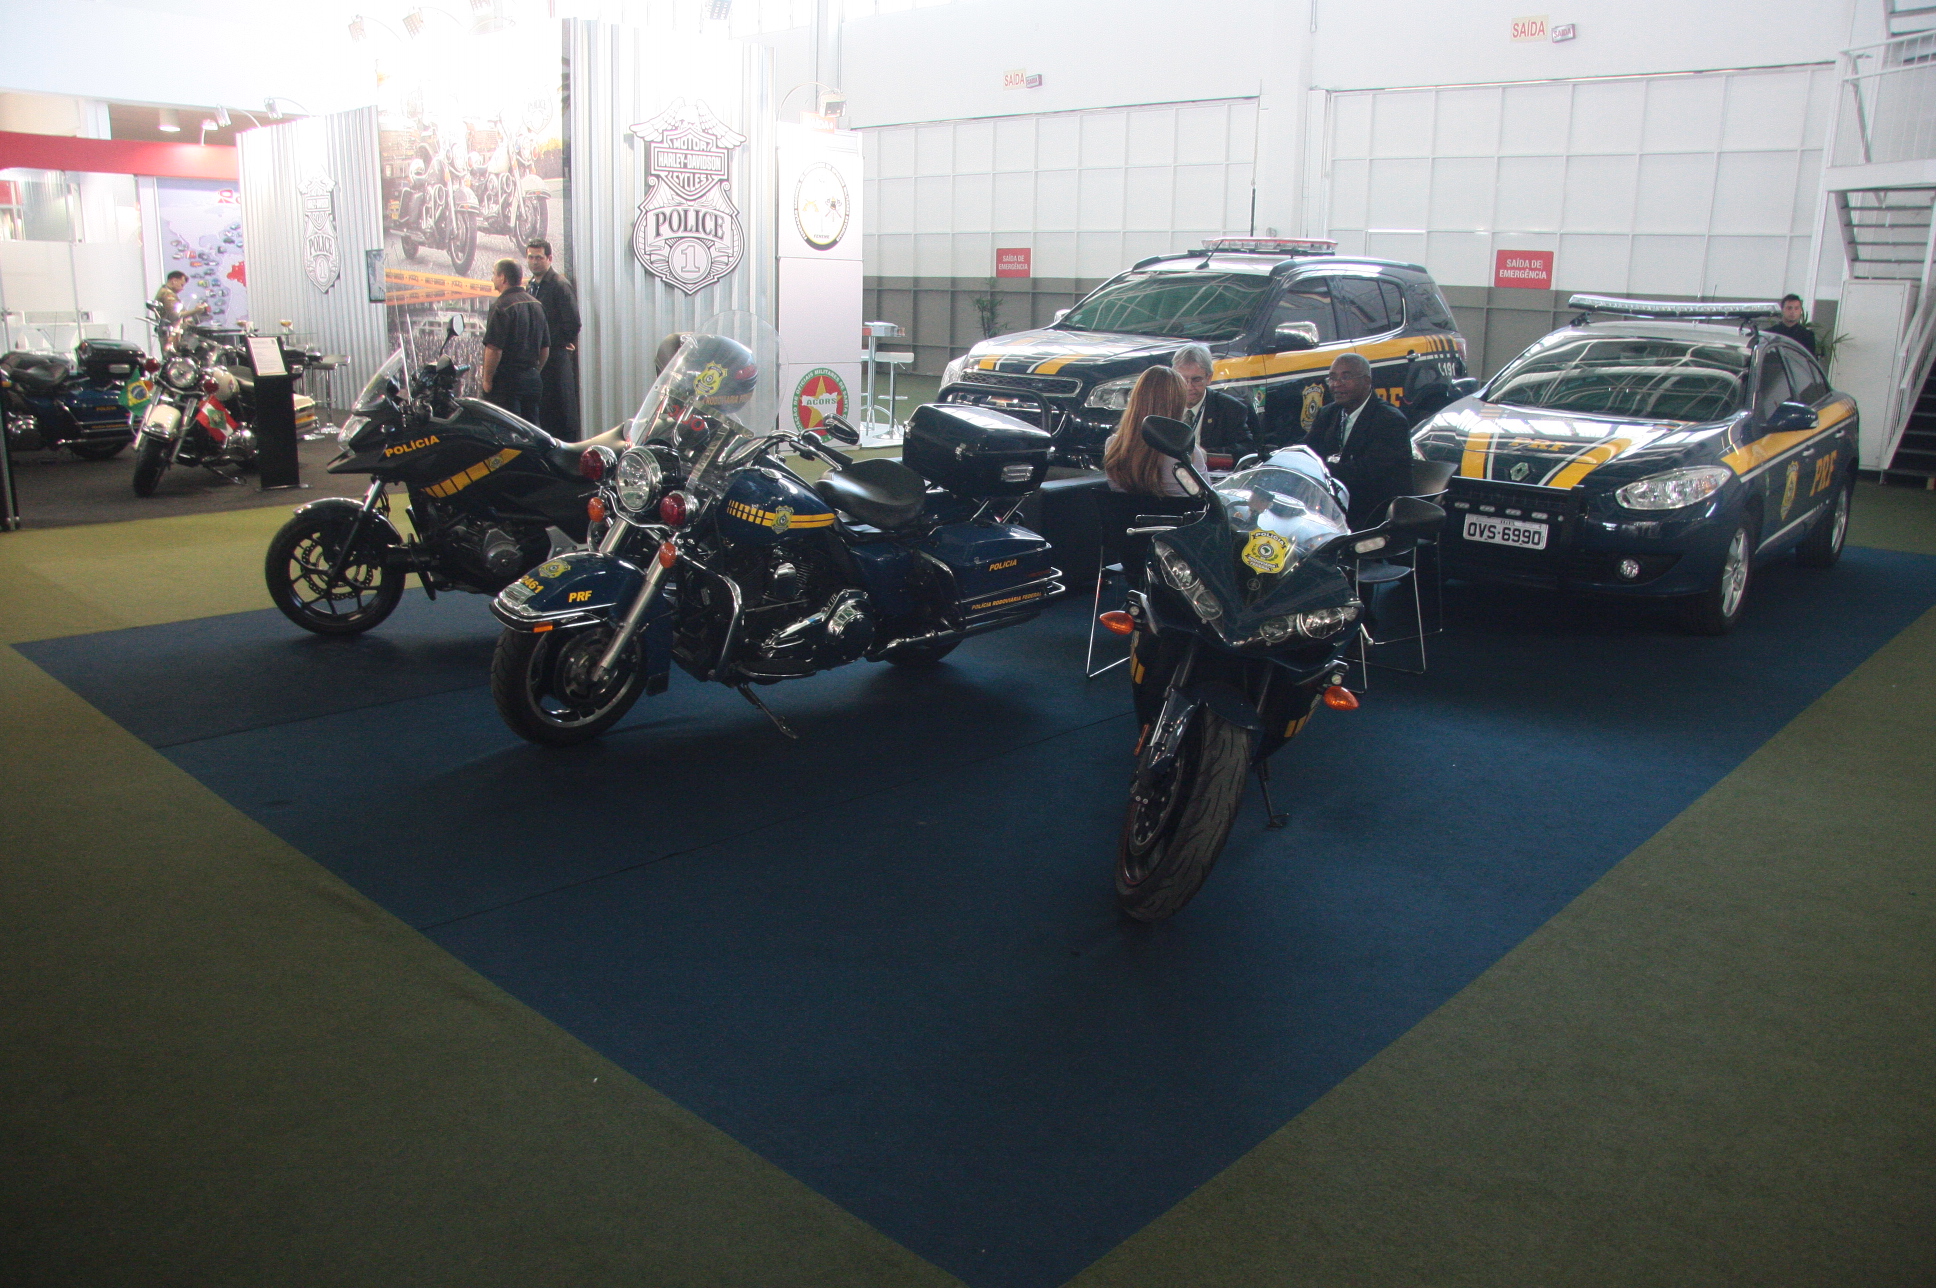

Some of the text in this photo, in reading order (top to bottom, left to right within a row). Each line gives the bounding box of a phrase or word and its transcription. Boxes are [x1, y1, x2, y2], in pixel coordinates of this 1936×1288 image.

[1512, 20, 1545, 38] SAÍDA
[1004, 72, 1025, 87] SAÍDA
[673, 137, 708, 151] MOTOR
[658, 151, 721, 171] HARLEY-DAVIDSON
[672, 173, 707, 191] CYCLES
[653, 207, 726, 240] POLICE
[308, 235, 334, 256] POLICE
[680, 244, 701, 273] 1
[998, 262, 1029, 270] EMERGÊNCIA
[1002, 254, 1017, 262] SAÍDA
[1506, 258, 1543, 269] SAÍDA DE
[1499, 269, 1547, 279] EMERGÊNCIA
[796, 372, 814, 394] OFICIAIS
[814, 369, 840, 383] MILITARES
[806, 397, 837, 406] ACORS
[1374, 387, 1404, 407] RF
[384, 435, 440, 458] POLÍCIA
[1508, 436, 1572, 451] PRF
[1809, 449, 1838, 497] PRF
[520, 575, 544, 594] 2461
[568, 590, 593, 603] PRF
